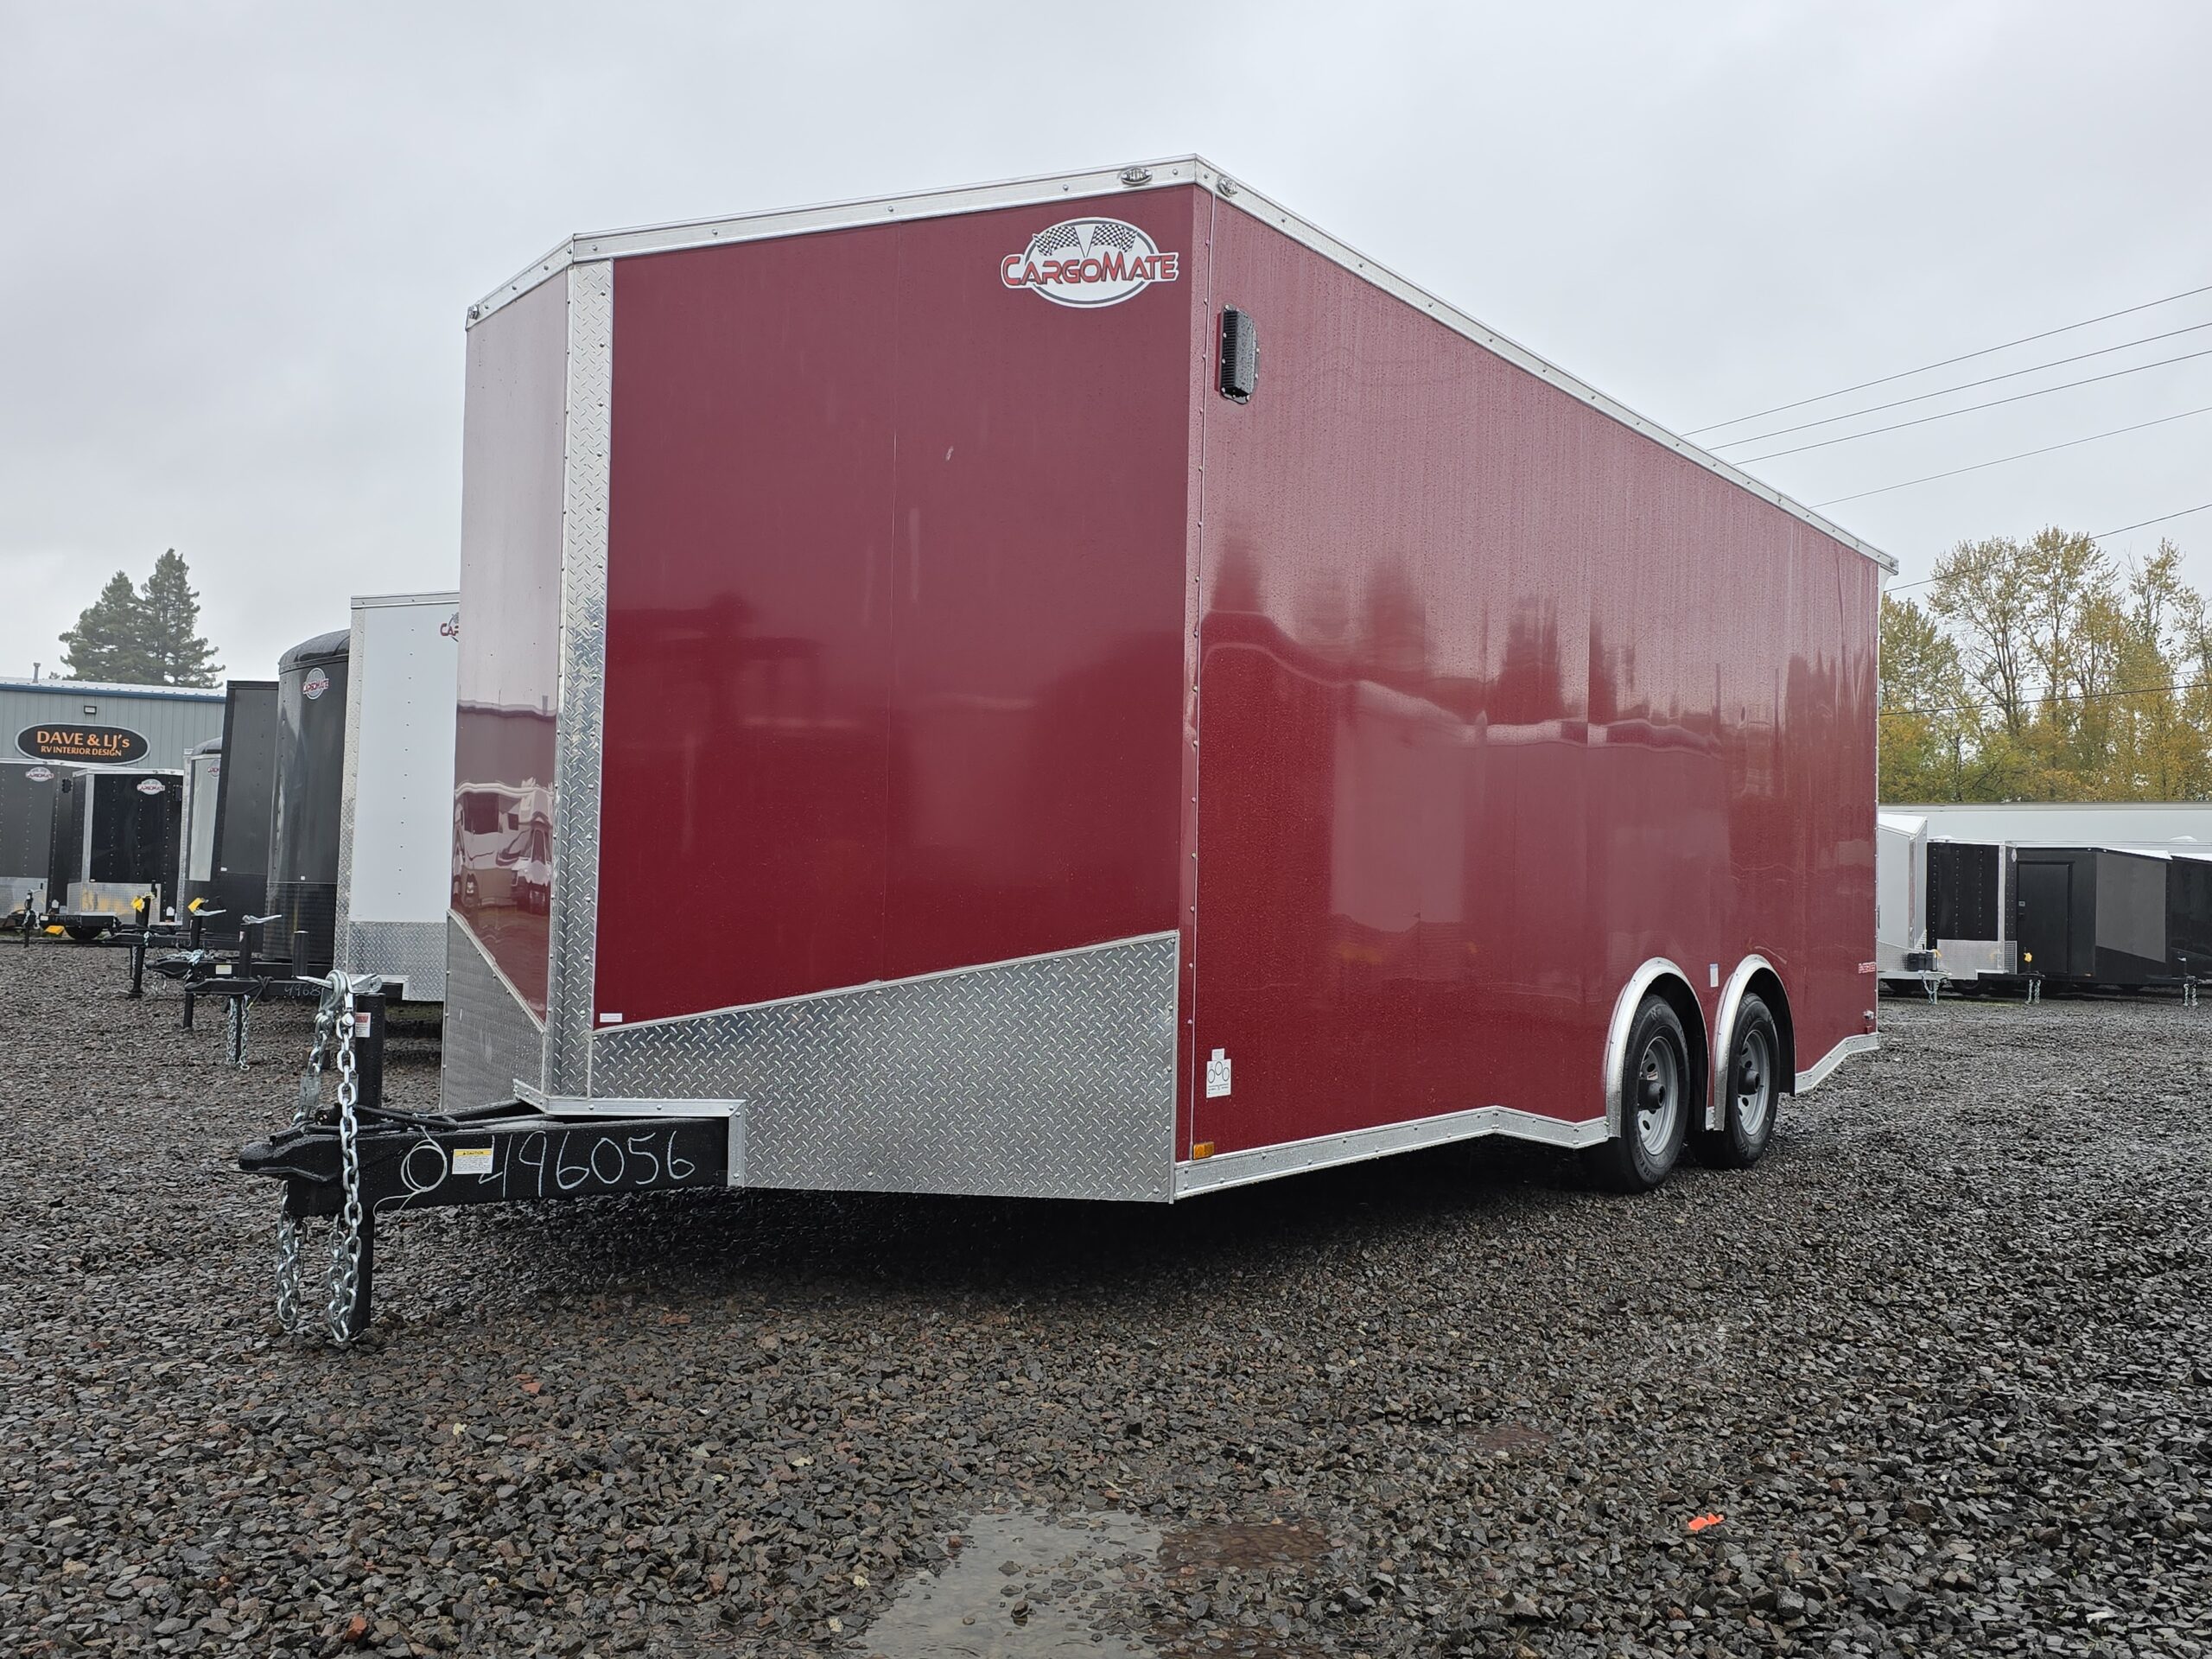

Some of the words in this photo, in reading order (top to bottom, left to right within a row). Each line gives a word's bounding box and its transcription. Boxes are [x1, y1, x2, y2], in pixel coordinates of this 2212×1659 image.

[37, 730, 84, 746] DAVE
[86, 734, 101, 746] &
[103, 734, 130, 750] LJ's
[53, 746, 91, 755] INTERIOR
[92, 747, 122, 756] DESIGN
[478, 1130, 696, 1198] 496056
